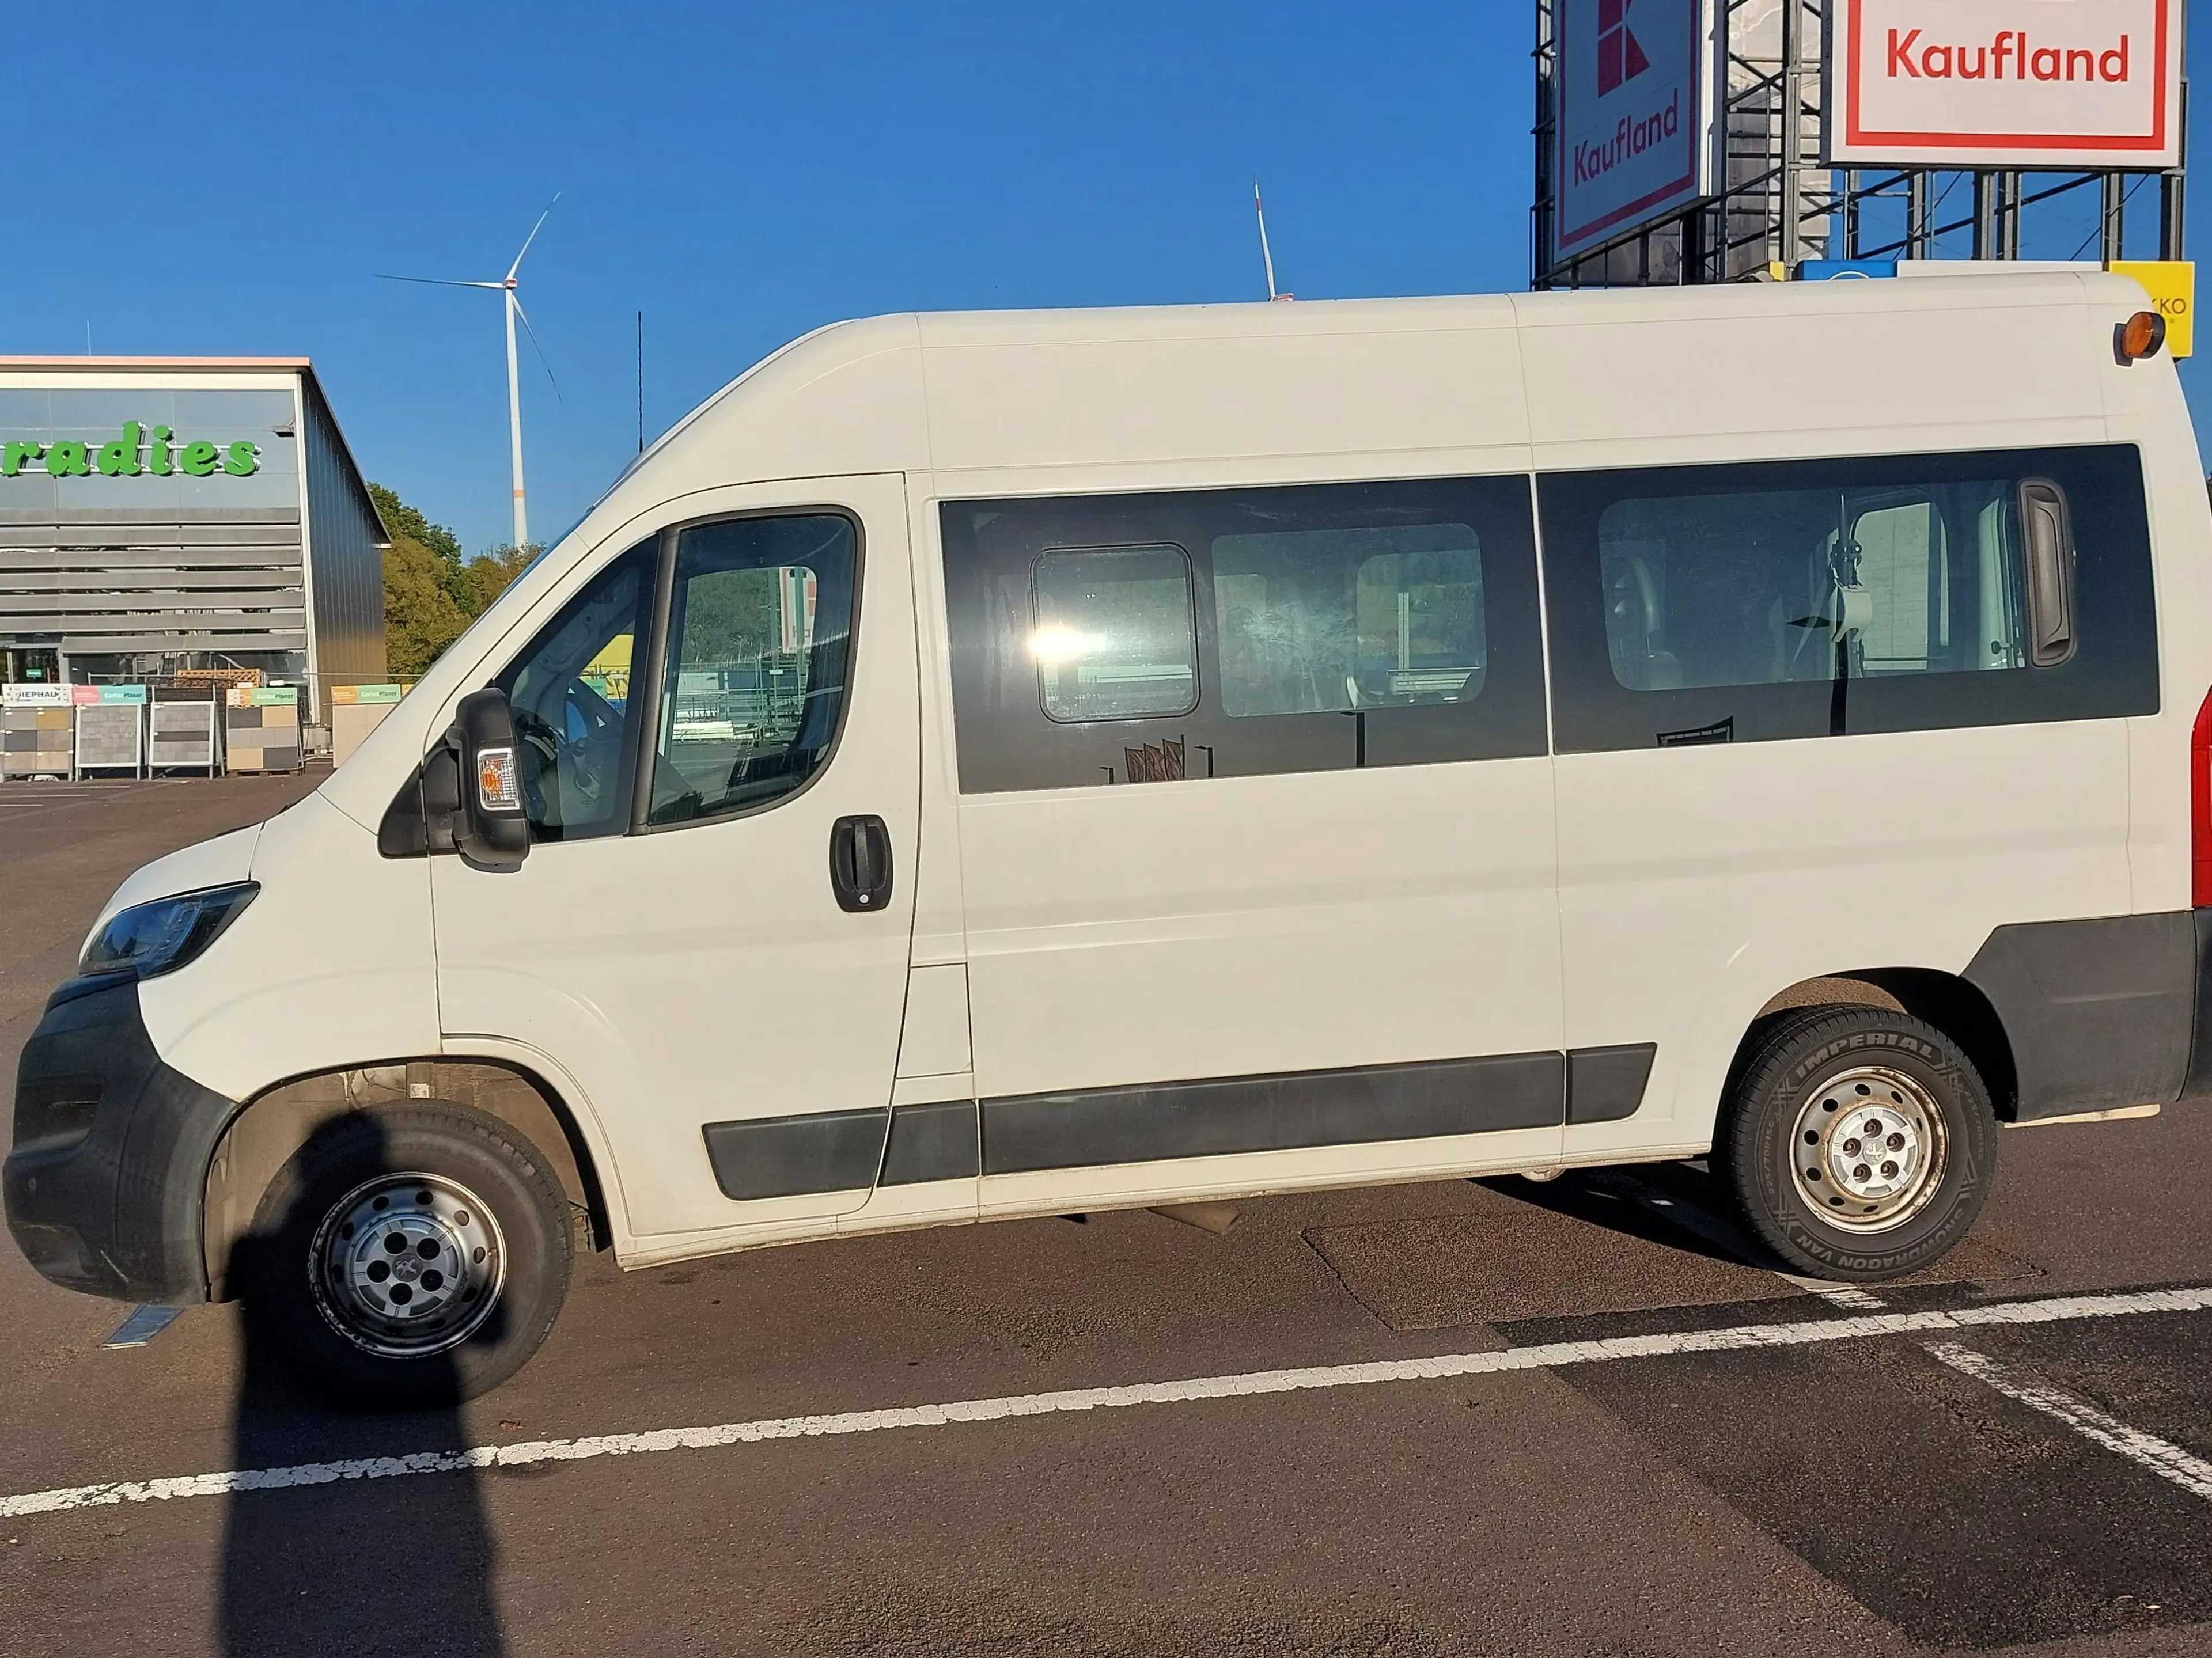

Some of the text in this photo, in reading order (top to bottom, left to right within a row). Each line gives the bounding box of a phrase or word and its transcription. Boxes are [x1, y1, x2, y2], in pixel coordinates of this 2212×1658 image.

[1887, 28, 2130, 82] Kaufland
[1574, 87, 1679, 188] Kaufland
[2152, 297, 2187, 315] KO
[2, 420, 261, 476] radies
[1795, 1033, 1933, 1079] IMPERIAL
[1796, 1208, 1964, 1270] SNOWDRAGON VAN
